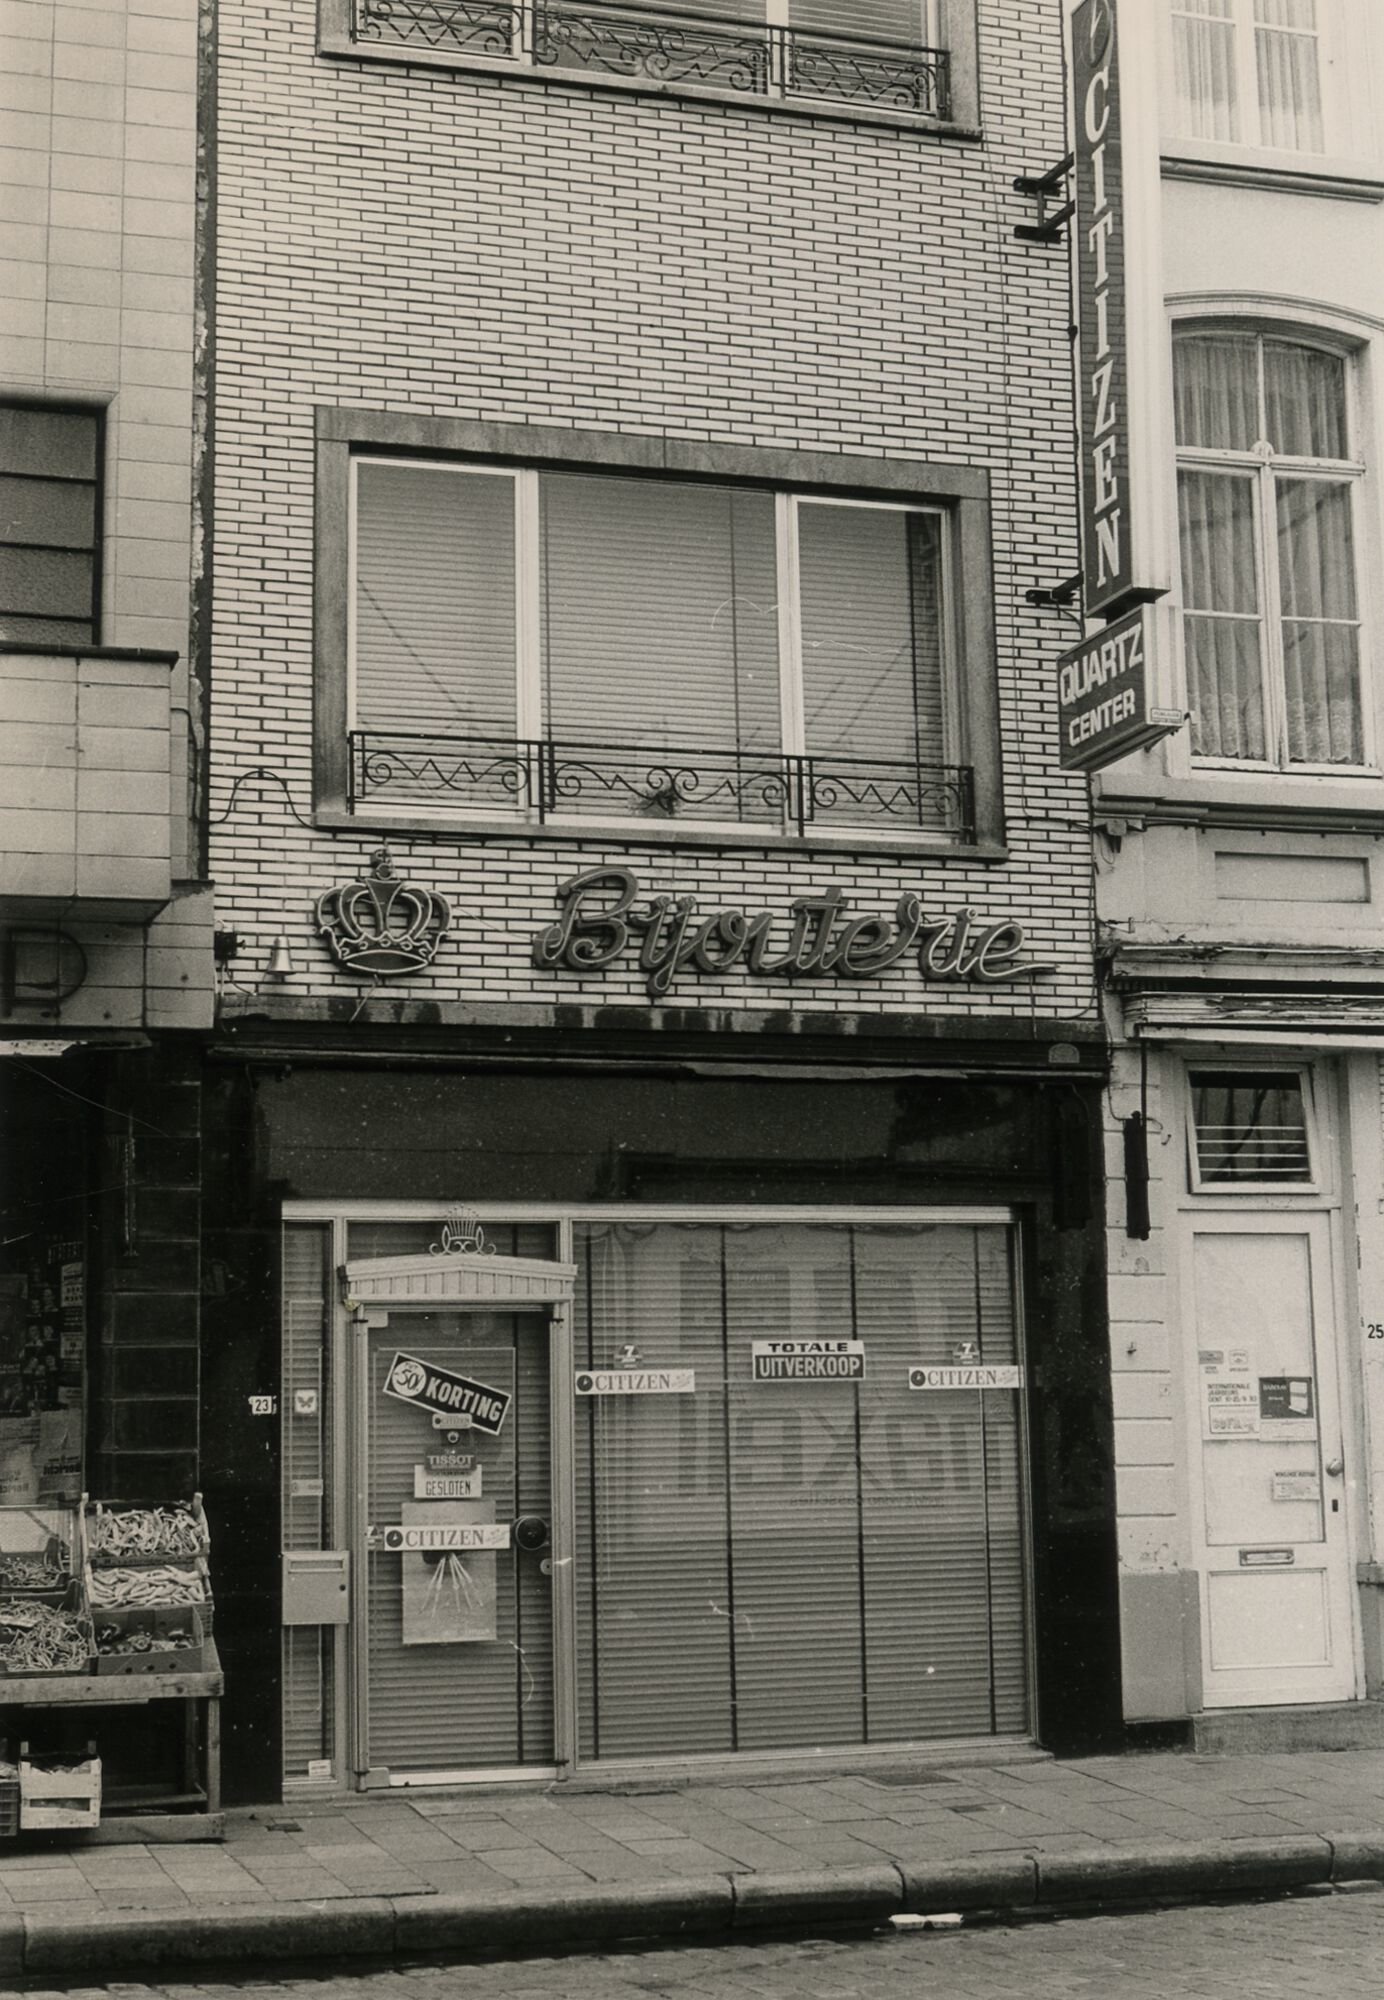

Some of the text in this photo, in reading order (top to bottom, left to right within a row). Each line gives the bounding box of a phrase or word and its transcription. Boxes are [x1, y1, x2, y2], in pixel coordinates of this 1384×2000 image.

[1085, 66, 1121, 588] CITIZEN
[1060, 622, 1144, 706] QUARTZ
[1069, 688, 1136, 747] CENTER
[533, 865, 1059, 996] Bijouterie
[1367, 1324, 1384, 1340] 25
[768, 1342, 849, 1353] TOTALE
[759, 1357, 861, 1378] UITVERKOOP
[594, 1373, 671, 1391] CITIZEN
[927, 1369, 998, 1387] CITIZEN
[255, 1399, 270, 1412] 23
[425, 1376, 503, 1422] KORTING
[427, 1455, 475, 1465] TISSOT
[426, 1480, 471, 1496] GESLOTEN
[405, 1529, 485, 1547] CITIZEN
